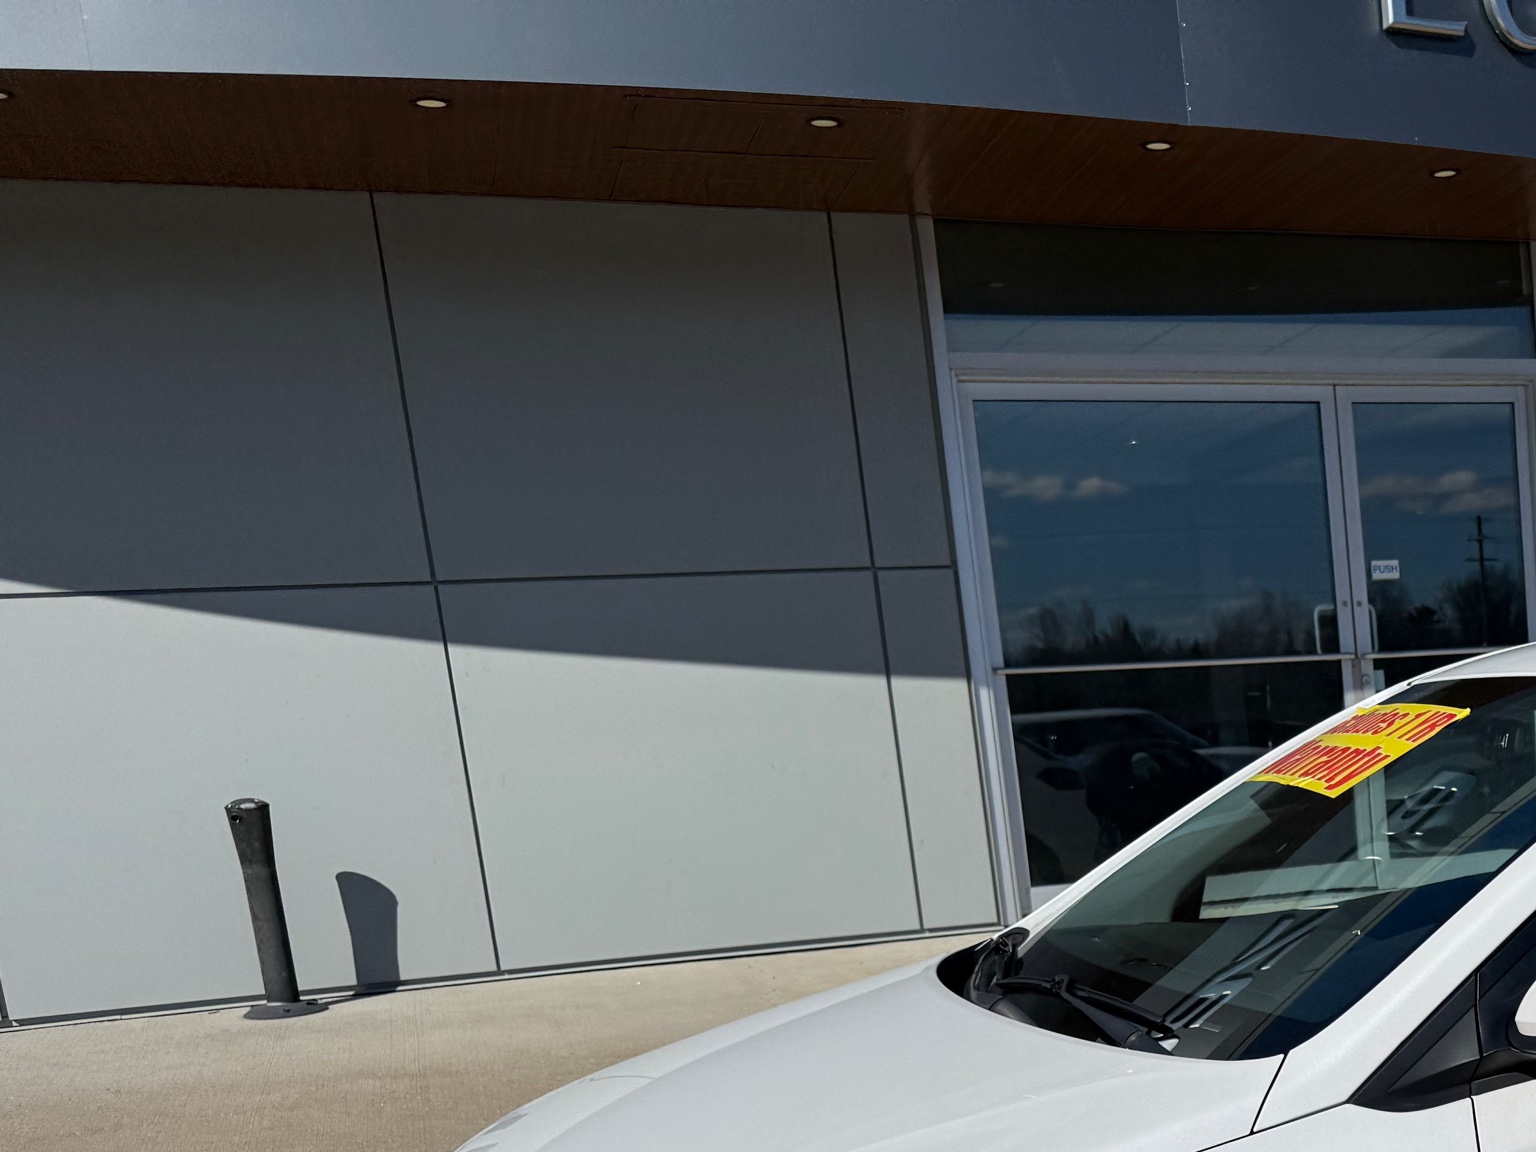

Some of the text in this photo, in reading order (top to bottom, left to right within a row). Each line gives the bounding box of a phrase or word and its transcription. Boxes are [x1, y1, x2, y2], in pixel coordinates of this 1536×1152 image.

[1372, 564, 1398, 575] PUSH
[1397, 711, 1458, 743] YR
[1258, 739, 1391, 790] Warranty
